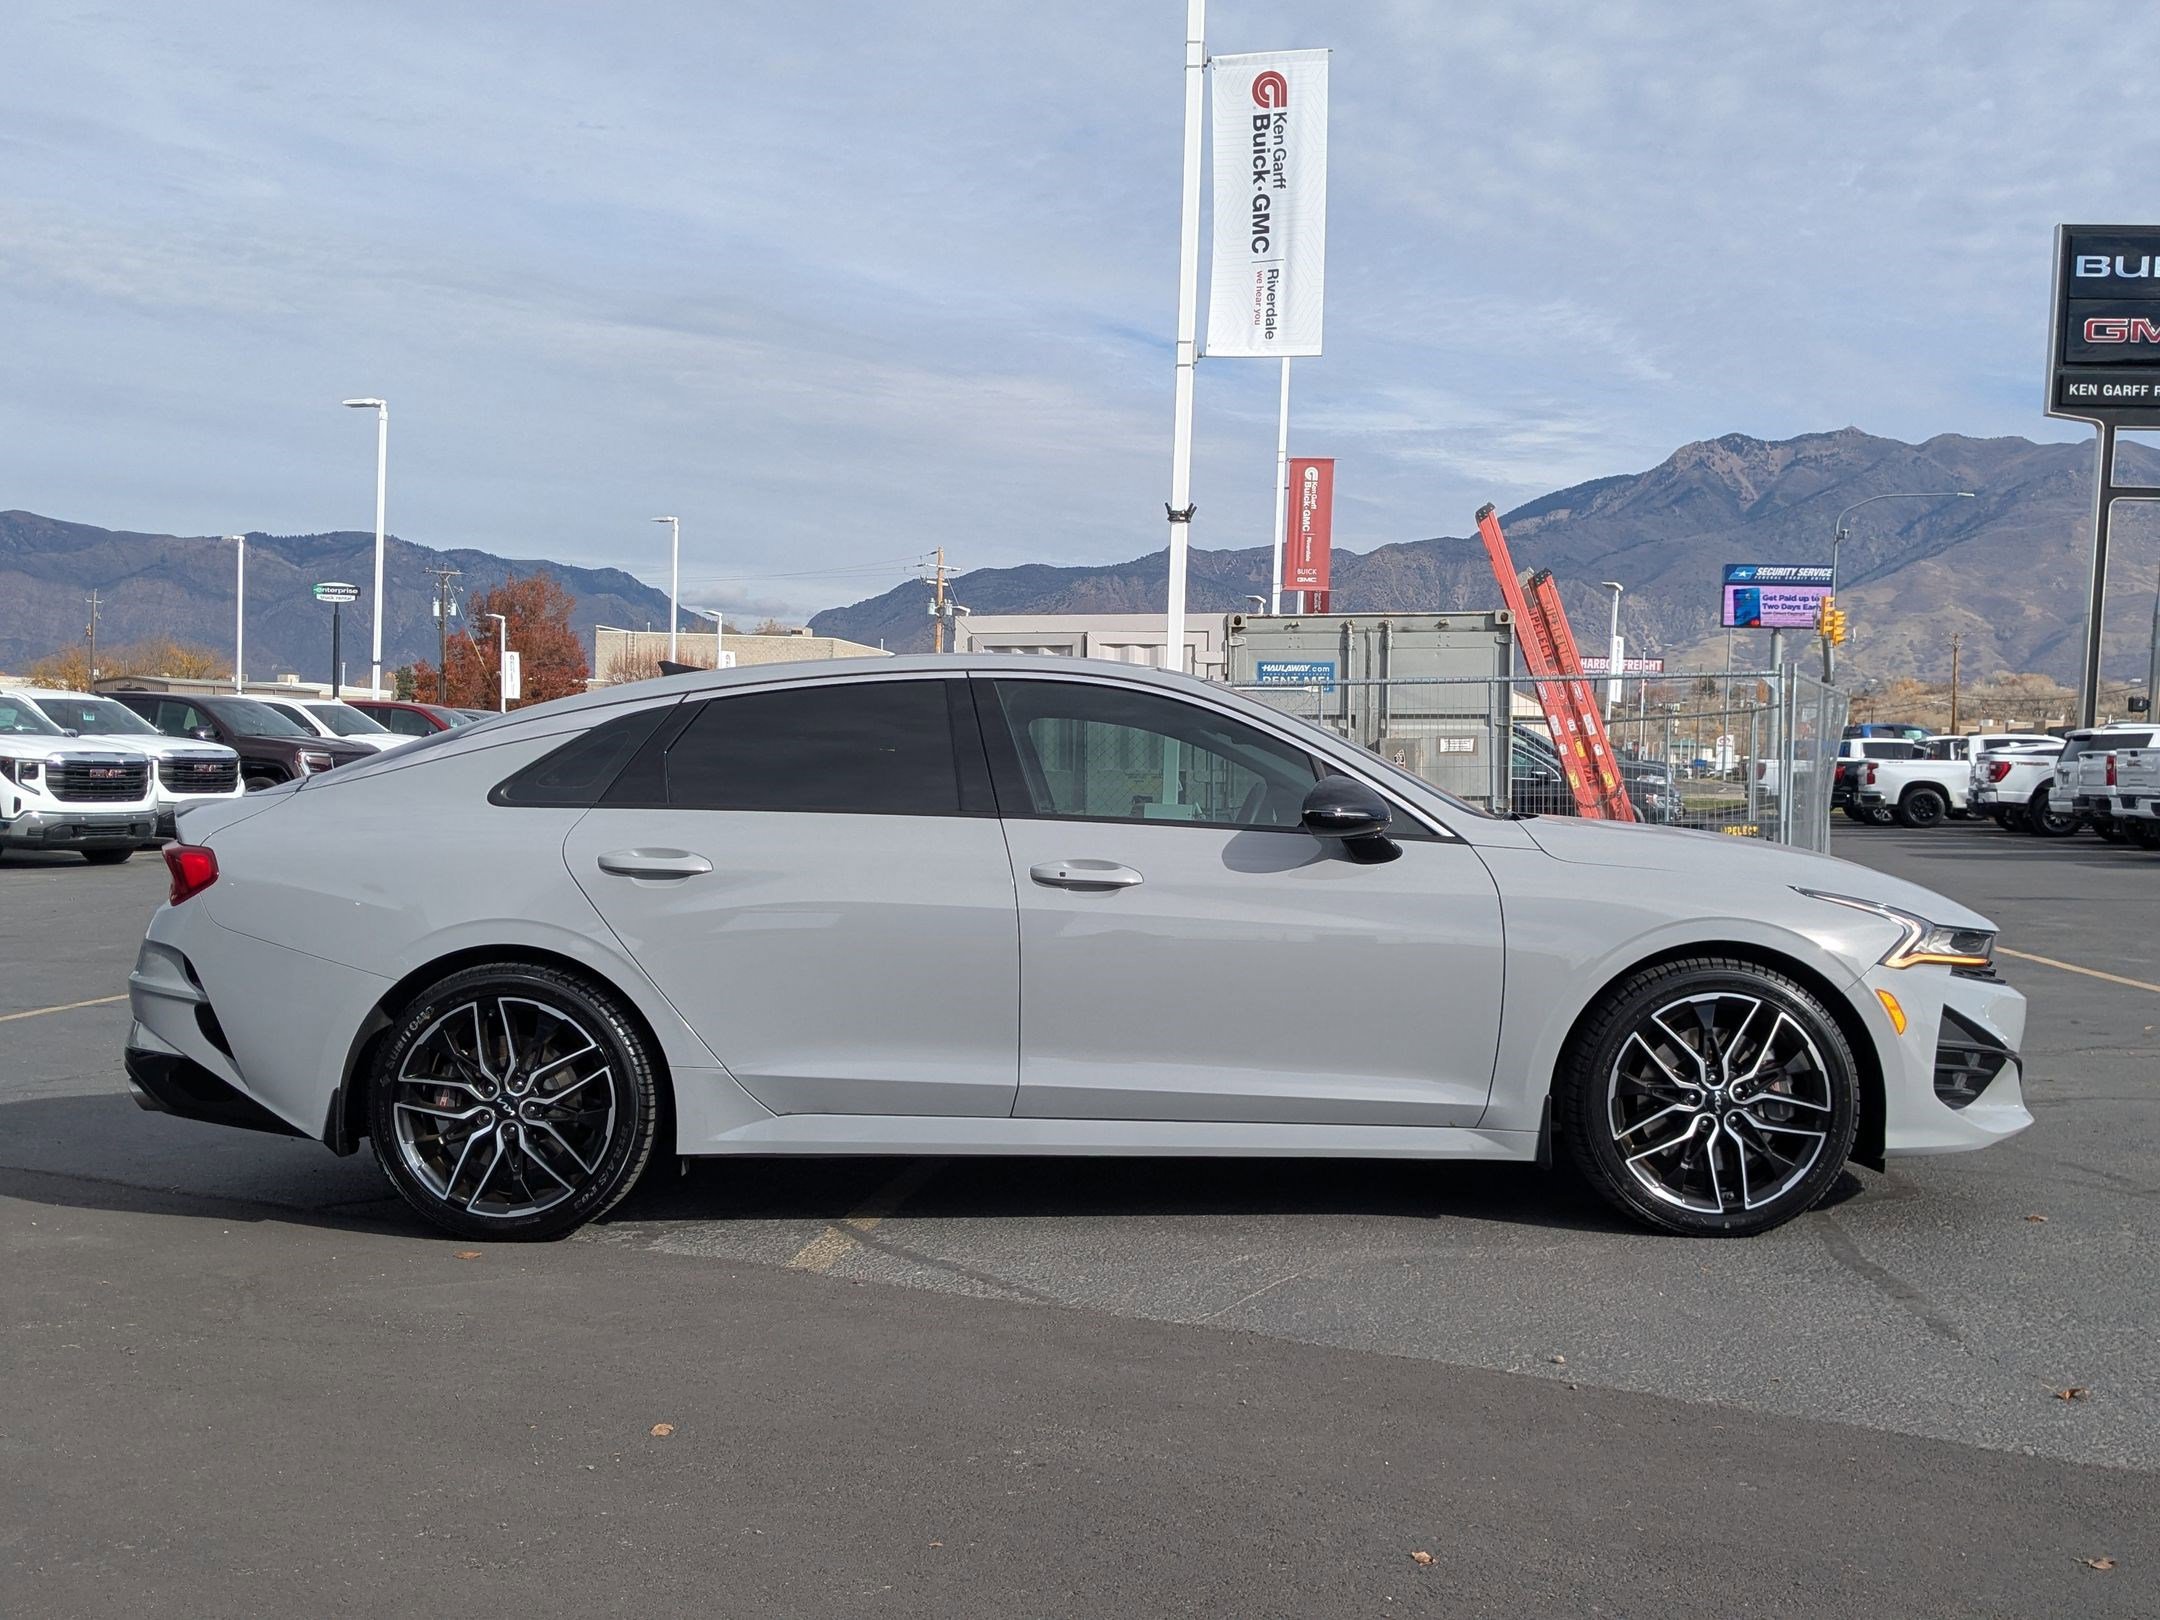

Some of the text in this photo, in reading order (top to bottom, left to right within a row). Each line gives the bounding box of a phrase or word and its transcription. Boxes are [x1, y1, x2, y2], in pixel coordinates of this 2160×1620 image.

[1272, 112, 1287, 189] Ken Garff
[1256, 270, 1263, 284] we
[1255, 285, 1264, 307] hear
[1264, 268, 1280, 340] Riverdale
[2069, 384, 2097, 395] KEN
[2103, 385, 2149, 396] GARFF
[1756, 567, 1833, 577] SECURITY SERVICE
[315, 586, 358, 594] enterprise
[1781, 603, 1801, 611] Days
[1581, 658, 1662, 671] HARBO FREIGHT
